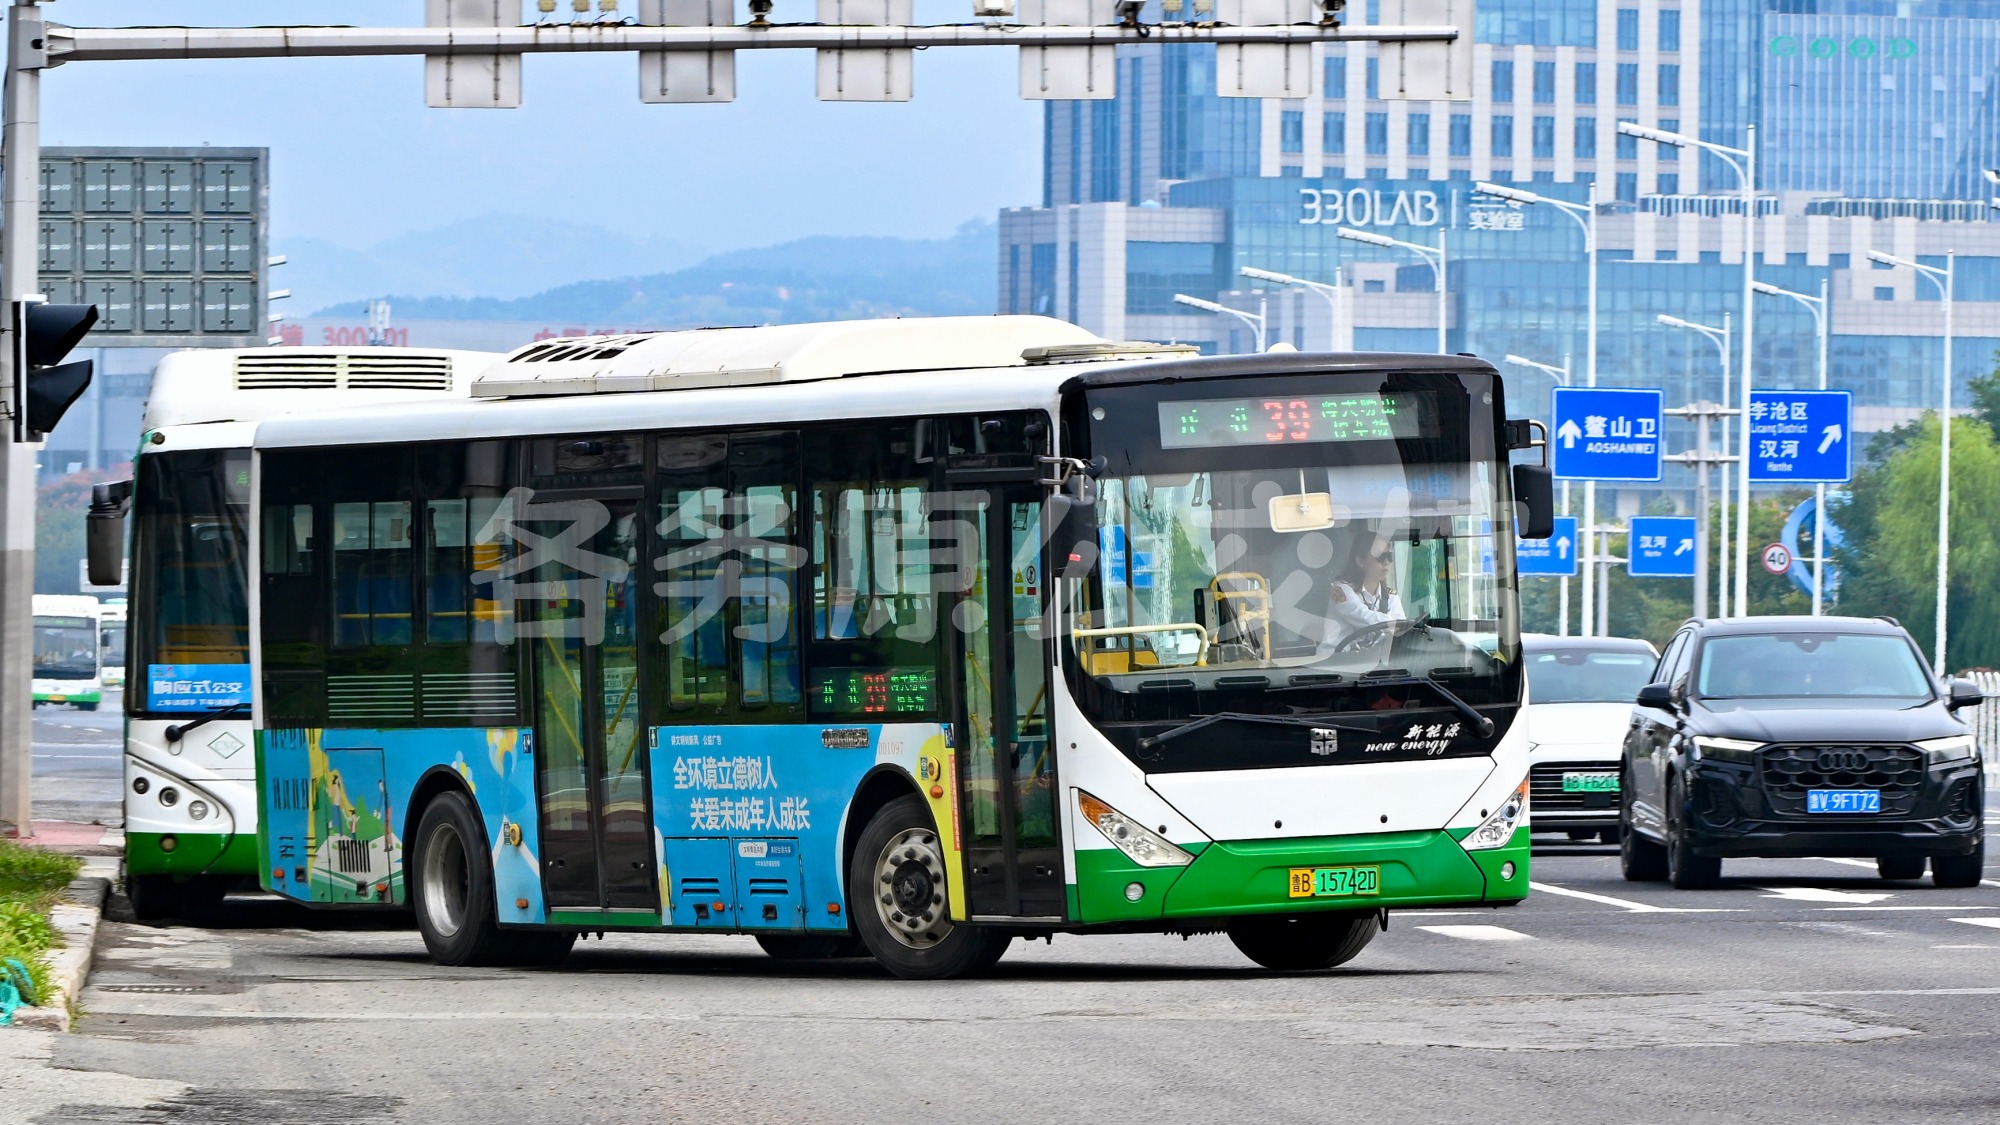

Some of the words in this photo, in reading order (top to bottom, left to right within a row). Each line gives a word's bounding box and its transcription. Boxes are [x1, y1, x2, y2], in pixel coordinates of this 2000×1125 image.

[1299, 188, 1439, 226] 330LAB
[1469, 210, 1524, 231] 实验室
[1750, 401, 1808, 420] 李沧区
[1758, 440, 1800, 459] 汉河
[1768, 552, 1787, 566] 40
[153, 680, 243, 695] 响应式公交
[1404, 723, 1461, 739] 新能源
[1365, 742, 1398, 753] new
[1401, 738, 1451, 756] energy
[672, 755, 778, 791] 全环境立德树人
[690, 796, 811, 831] 关爱未成年人成长
